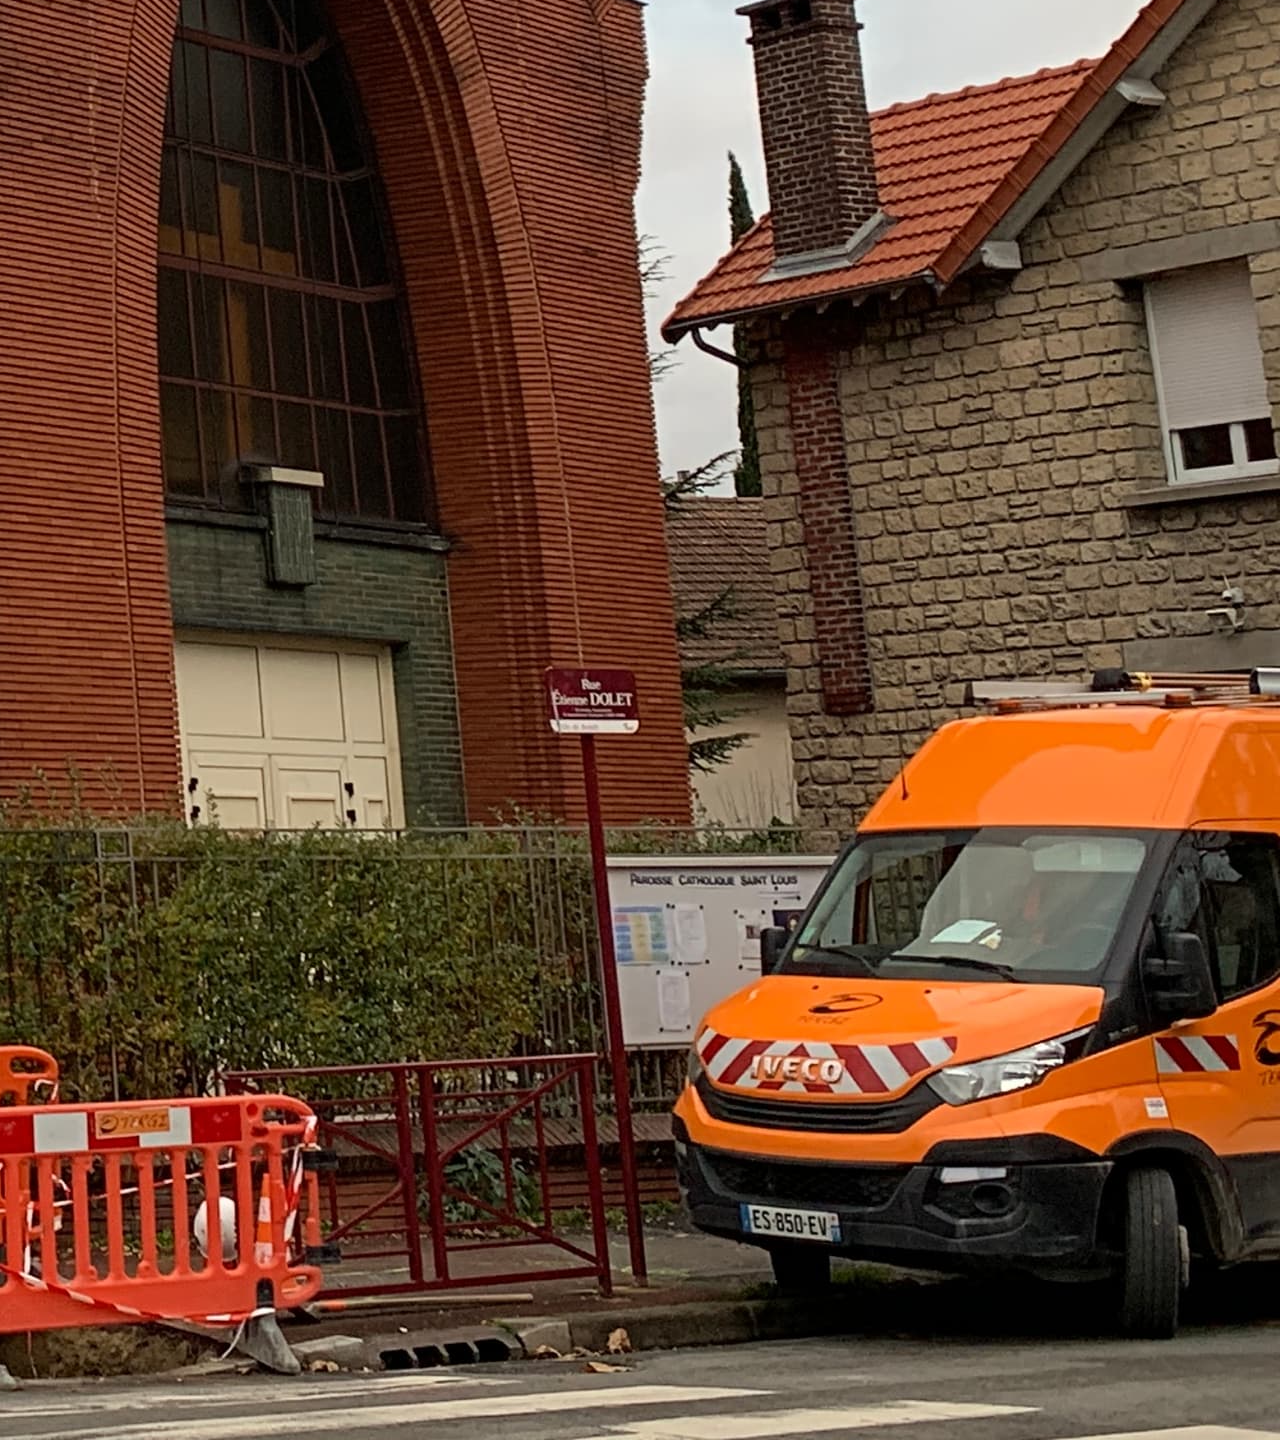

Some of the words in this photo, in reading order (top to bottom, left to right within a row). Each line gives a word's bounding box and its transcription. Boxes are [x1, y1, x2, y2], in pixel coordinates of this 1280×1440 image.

[581, 678, 601, 691] Rue
[589, 692, 633, 706] DOLET
[750, 1054, 843, 1084] IVECO
[752, 1209, 827, 1236] ES-850-EV
